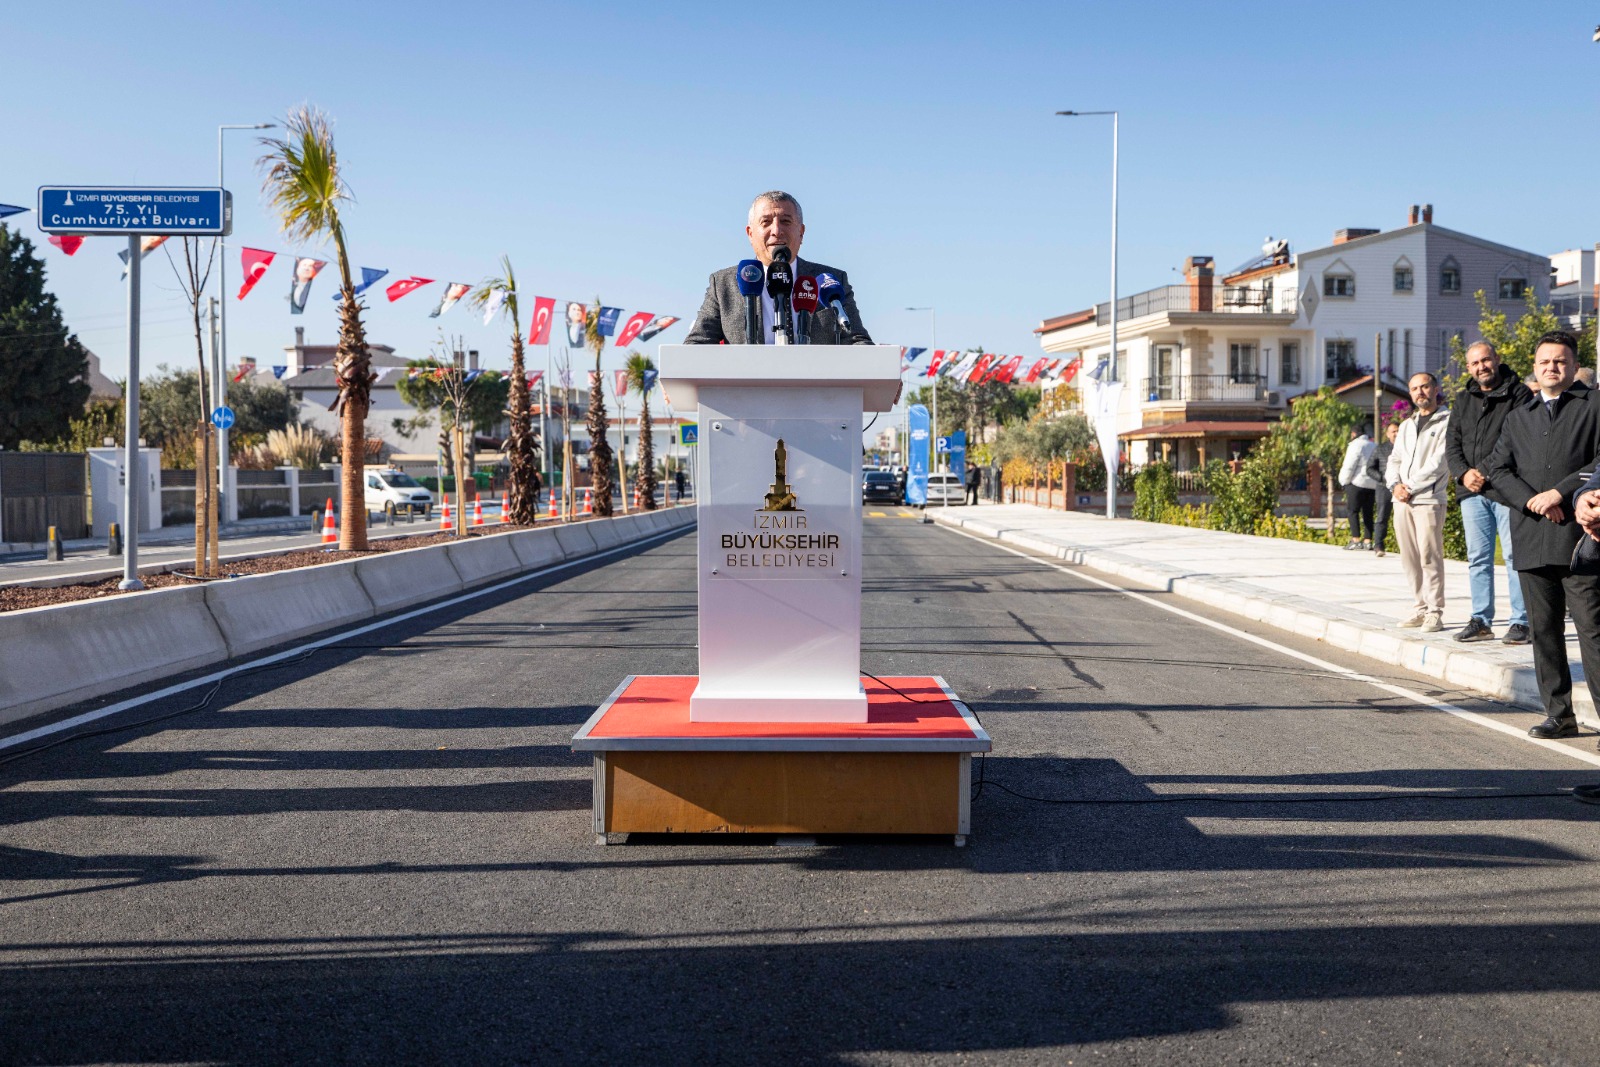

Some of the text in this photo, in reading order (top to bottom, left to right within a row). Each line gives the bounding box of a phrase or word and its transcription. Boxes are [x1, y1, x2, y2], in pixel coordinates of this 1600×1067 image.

[104, 204, 158, 215] 75. Yıl
[51, 214, 210, 227] Cumhuriyet Bulvarı
[937, 437, 947, 452] P
[754, 513, 807, 529] İZMİR
[721, 531, 839, 552] BÜYÜKŞEHİR
[726, 551, 834, 567] BELEDİYESİ
